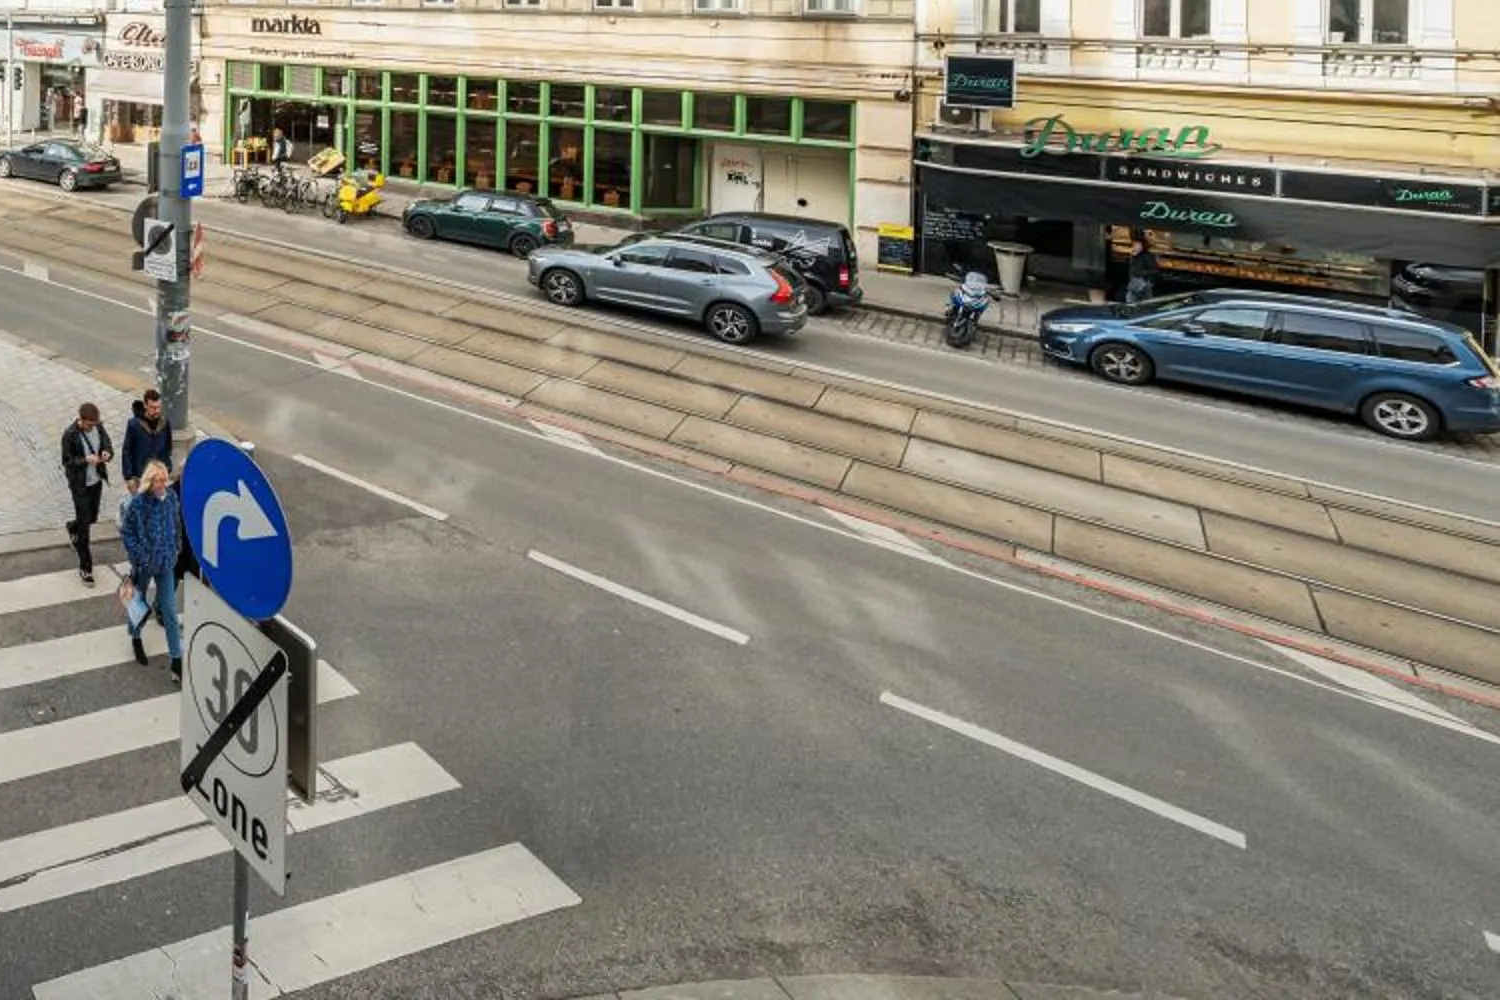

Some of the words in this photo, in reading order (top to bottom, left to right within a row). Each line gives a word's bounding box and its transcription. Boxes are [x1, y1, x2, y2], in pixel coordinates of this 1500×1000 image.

[251, 14, 322, 35] markta
[950, 73, 1010, 90] Duran
[1020, 114, 1223, 159] Duran
[1119, 166, 1262, 186] SANDWICHES
[1395, 188, 1453, 201] Duran
[1140, 201, 1238, 227] Duran
[205, 642, 258, 754] 30
